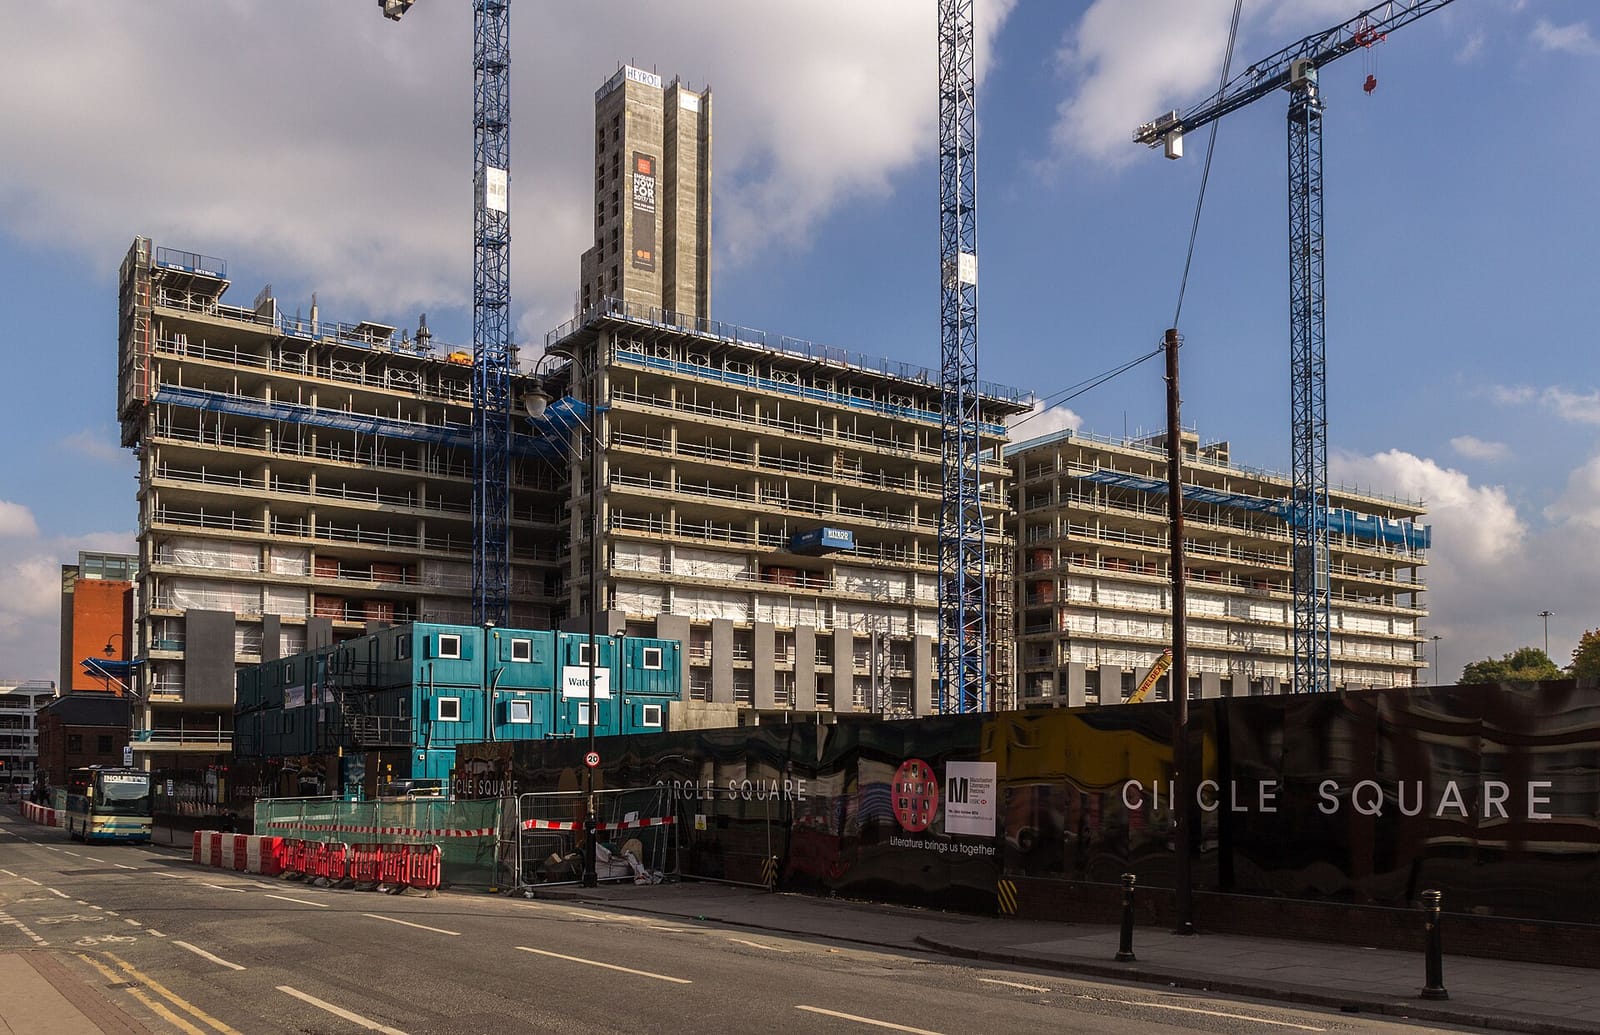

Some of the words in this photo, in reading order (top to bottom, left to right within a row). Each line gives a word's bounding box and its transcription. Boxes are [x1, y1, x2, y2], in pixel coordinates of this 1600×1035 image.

[634, 178, 655, 189] NOW
[634, 184, 654, 199] FOR
[568, 677, 596, 688] Wate
[1140, 664, 1162, 693] WELDEX
[588, 755, 598, 764] 20
[478, 779, 519, 796] SQUARE
[728, 779, 807, 801] SQUARE
[1122, 779, 1278, 813] CICLE
[1317, 779, 1553, 820] SQUARE
[890, 835, 923, 849] Literature
[924, 840, 948, 853] brings
[949, 843, 959, 853] us
[960, 843, 996, 856] together
